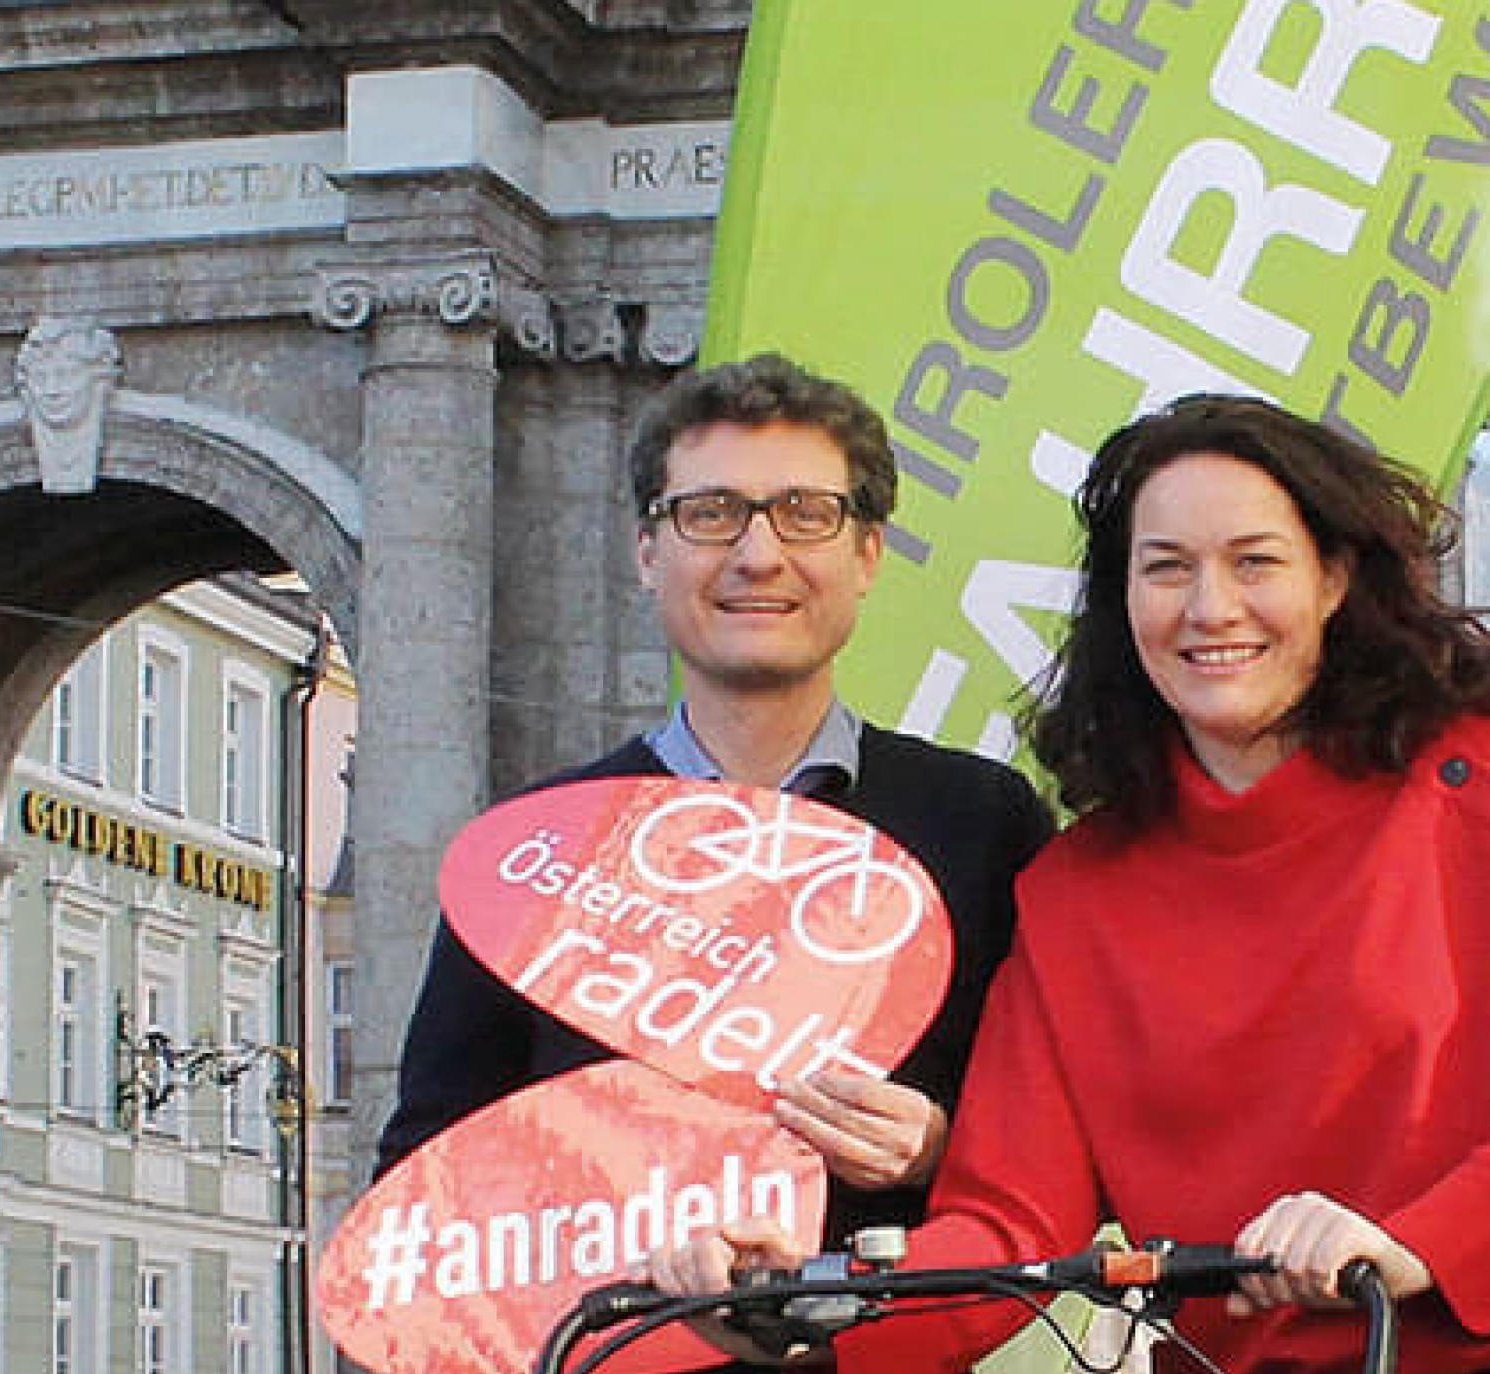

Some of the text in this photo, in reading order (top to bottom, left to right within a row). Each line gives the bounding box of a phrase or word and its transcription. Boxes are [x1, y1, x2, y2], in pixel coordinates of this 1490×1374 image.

[613, 143, 726, 190] PRAE
[498, 828, 778, 985] Österreich
[515, 928, 890, 1090] radelt
[363, 1155, 795, 1310] #anradeln
